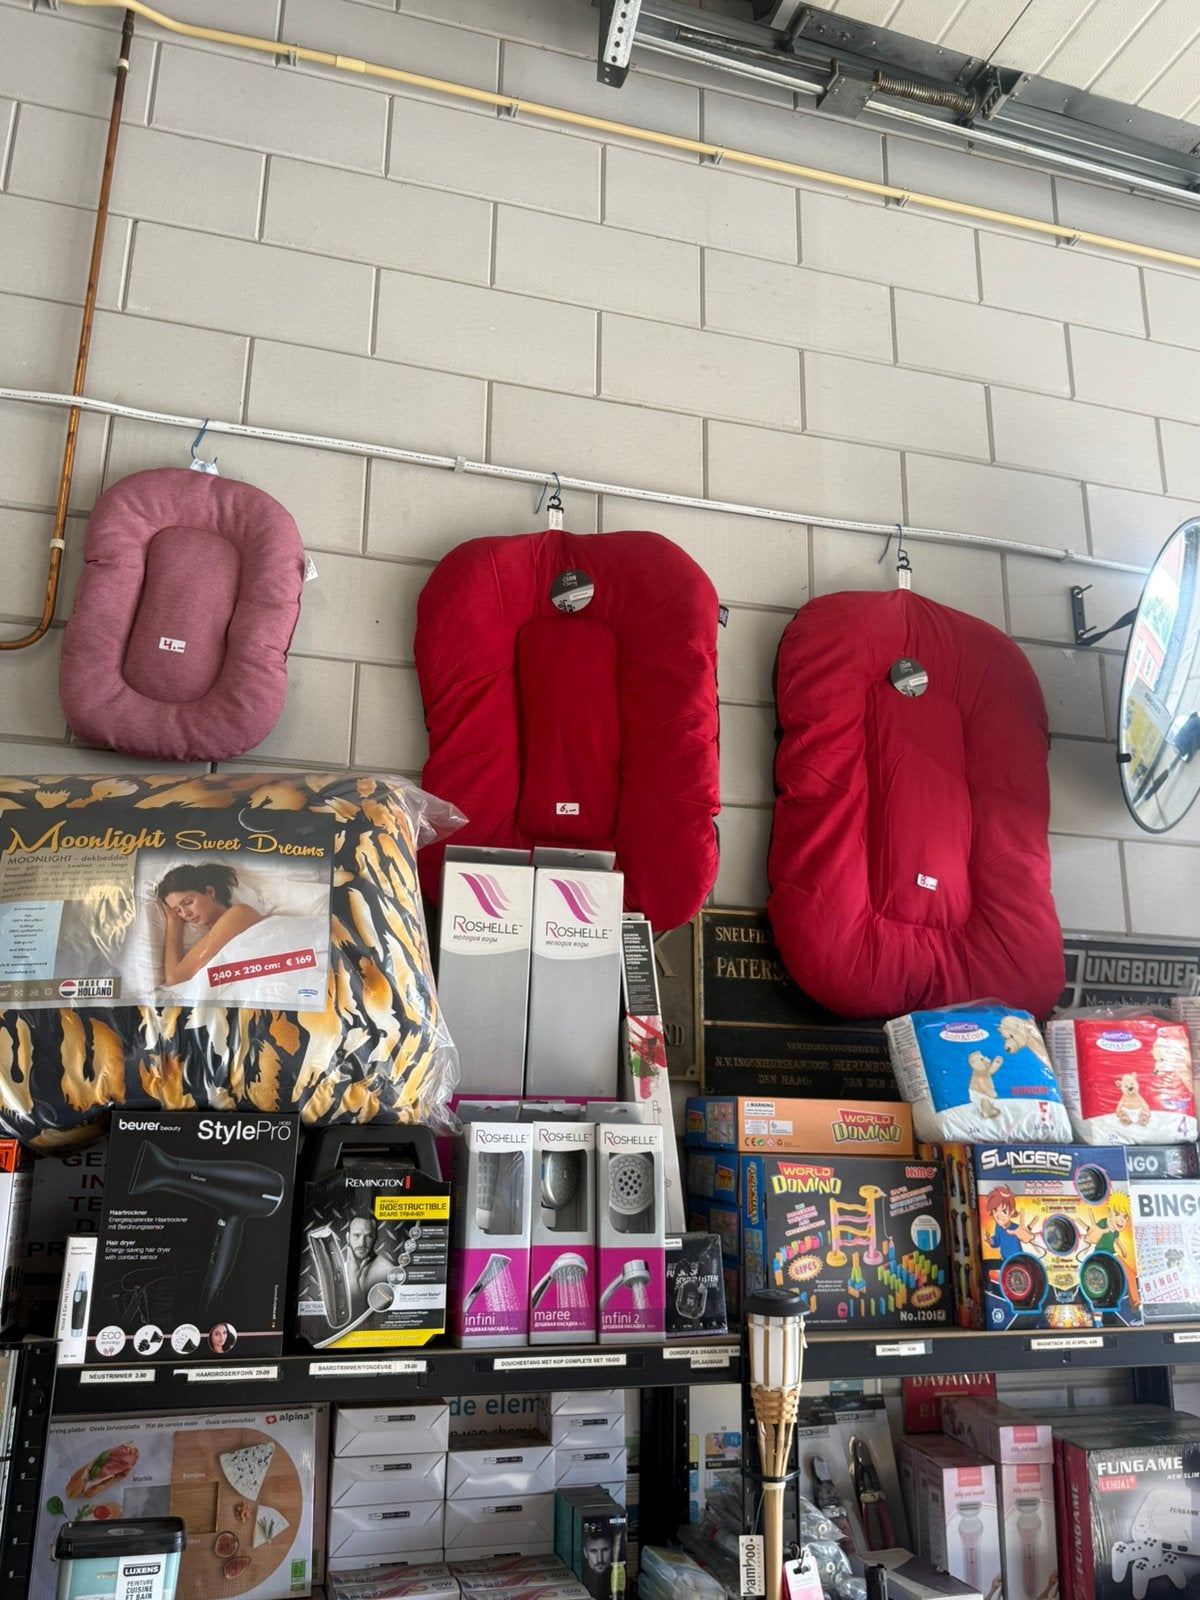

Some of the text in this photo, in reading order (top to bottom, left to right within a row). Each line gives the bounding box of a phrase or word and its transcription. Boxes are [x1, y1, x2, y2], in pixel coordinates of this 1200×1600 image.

[7, 819, 325, 858] Moonlight Sweet Dreams
[8, 854, 129, 865] MOONLIGHT dekbedden
[453, 915, 519, 935] ROSHELLE
[545, 921, 609, 939] ROSHELLE
[212, 969, 232, 981] 240
[242, 964, 262, 974] 220
[264, 962, 281, 971] cm:
[285, 958, 293, 966] €
[295, 955, 312, 965] 169
[78, 987, 112, 997] HOLLAND
[946, 1023, 979, 1032] SweetCare
[1102, 1033, 1133, 1041] SweetCare
[119, 1119, 160, 1131] beurer
[844, 1114, 891, 1125] WORLD
[198, 1119, 291, 1145] StylePro
[833, 1121, 902, 1143] DOMINO
[1178, 1116, 1189, 1137] 4
[476, 1129, 526, 1144] ROSHELLE
[538, 1128, 589, 1143] ROSHELLE
[604, 1131, 654, 1145] ROSHELLE
[981, 1148, 1073, 1172] SLINGERS
[783, 1166, 831, 1178] WORLD
[345, 1177, 404, 1188] REMINGTON
[771, 1174, 843, 1195] DOMINO
[379, 1202, 447, 1211] INDESTRUCTIBLE
[120, 1239, 136, 1247] dryer
[1144, 1271, 1180, 1293] BINGO
[465, 1314, 496, 1326] infini
[534, 1310, 571, 1321] maree
[601, 1313, 640, 1325] infini 2
[101, 1331, 121, 1340] ECO
[89, 1372, 133, 1380] NEUSTRIMMER
[449, 1395, 477, 1417] de
[279, 1412, 310, 1423] alpina
[49, 1427, 66, 1435] erving
[106, 1423, 140, 1432] Servierplatte
[1097, 1456, 1183, 1475] FUNGAME
[1169, 1507, 1199, 1516] FUNGAME
[1071, 1482, 1084, 1574] FUNGAME
[125, 1566, 159, 1575] LUXENS
[742, 1543, 756, 1595] bamboo
